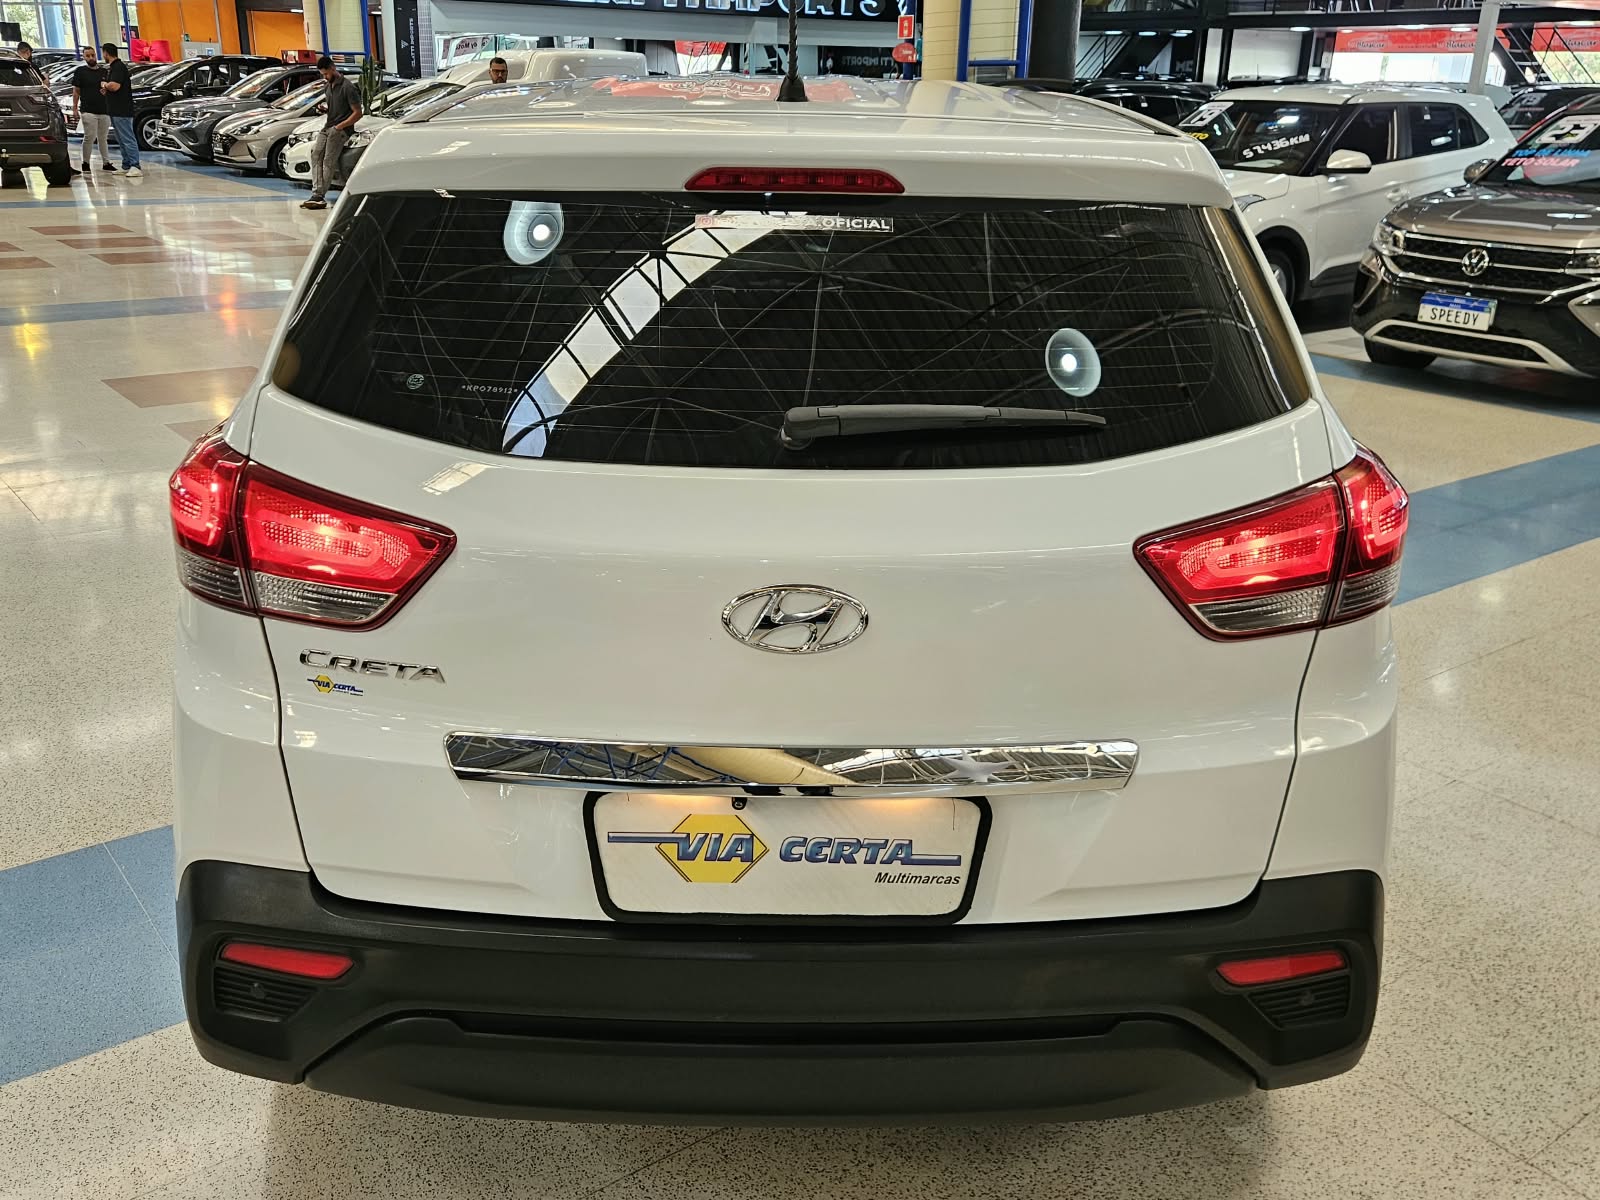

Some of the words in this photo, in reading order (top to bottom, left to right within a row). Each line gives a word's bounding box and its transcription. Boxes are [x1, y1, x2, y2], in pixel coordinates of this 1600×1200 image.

[1430, 307, 1480, 326] SPEEDY
[299, 648, 446, 683] CRETA
[333, 683, 357, 692] CERTA
[676, 832, 754, 863] VIA
[779, 836, 913, 866] CERTA
[874, 871, 961, 886] Multimarcas
